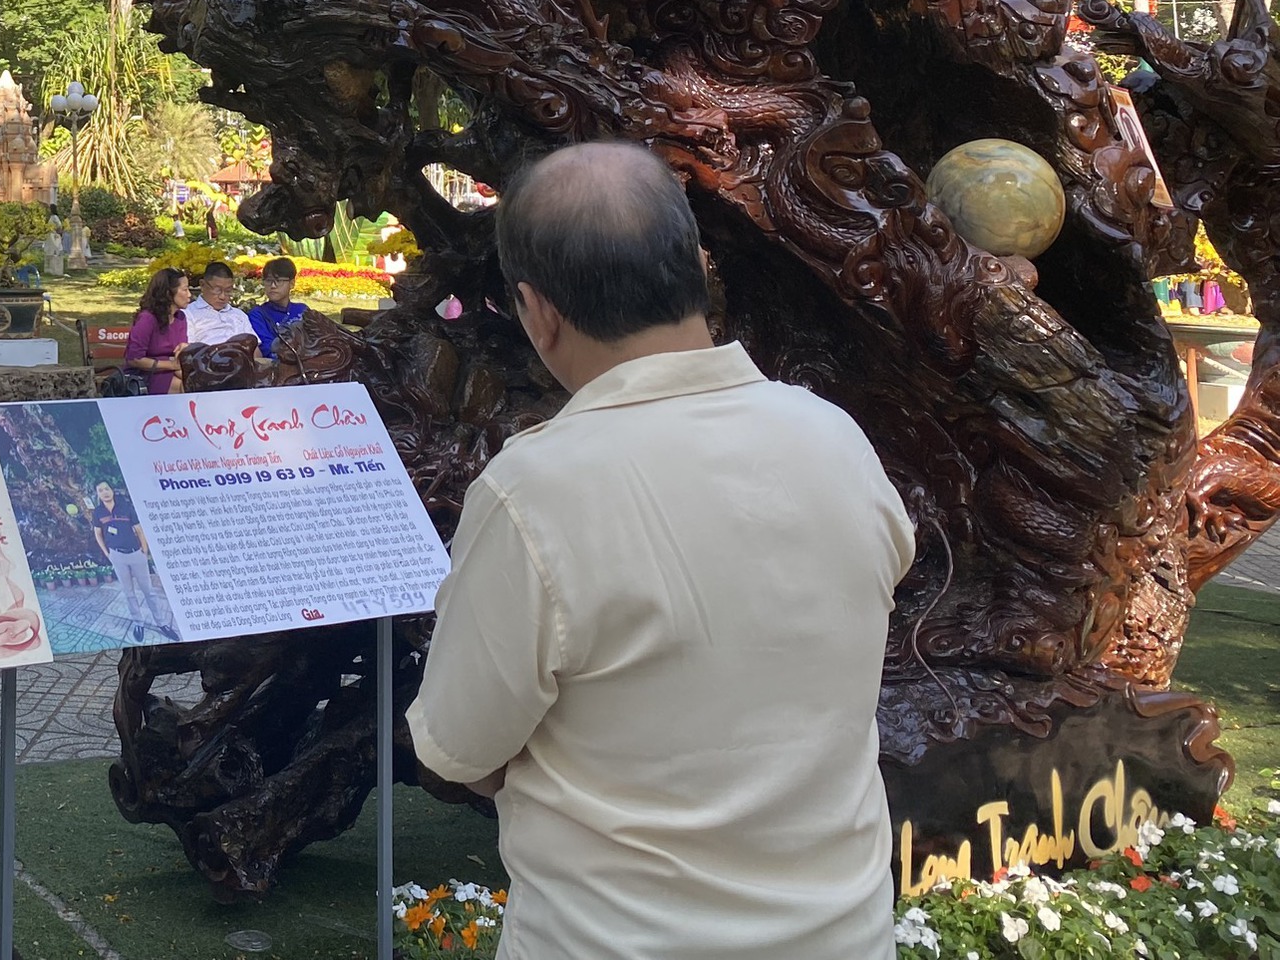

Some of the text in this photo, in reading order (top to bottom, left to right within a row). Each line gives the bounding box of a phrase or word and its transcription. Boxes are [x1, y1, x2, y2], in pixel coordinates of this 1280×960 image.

[189, 401, 244, 449] Long
[241, 406, 303, 441] Tranh
[311, 404, 367, 429] Châu
[159, 478, 211, 490] Phone:
[215, 471, 252, 485] 0919
[256, 470, 271, 482] 19
[276, 468, 295, 480] 63
[299, 466, 314, 478] 19
[329, 463, 353, 475] Mr.
[176, 459, 188, 471] Gia
[977, 768, 1075, 874] Tranh
